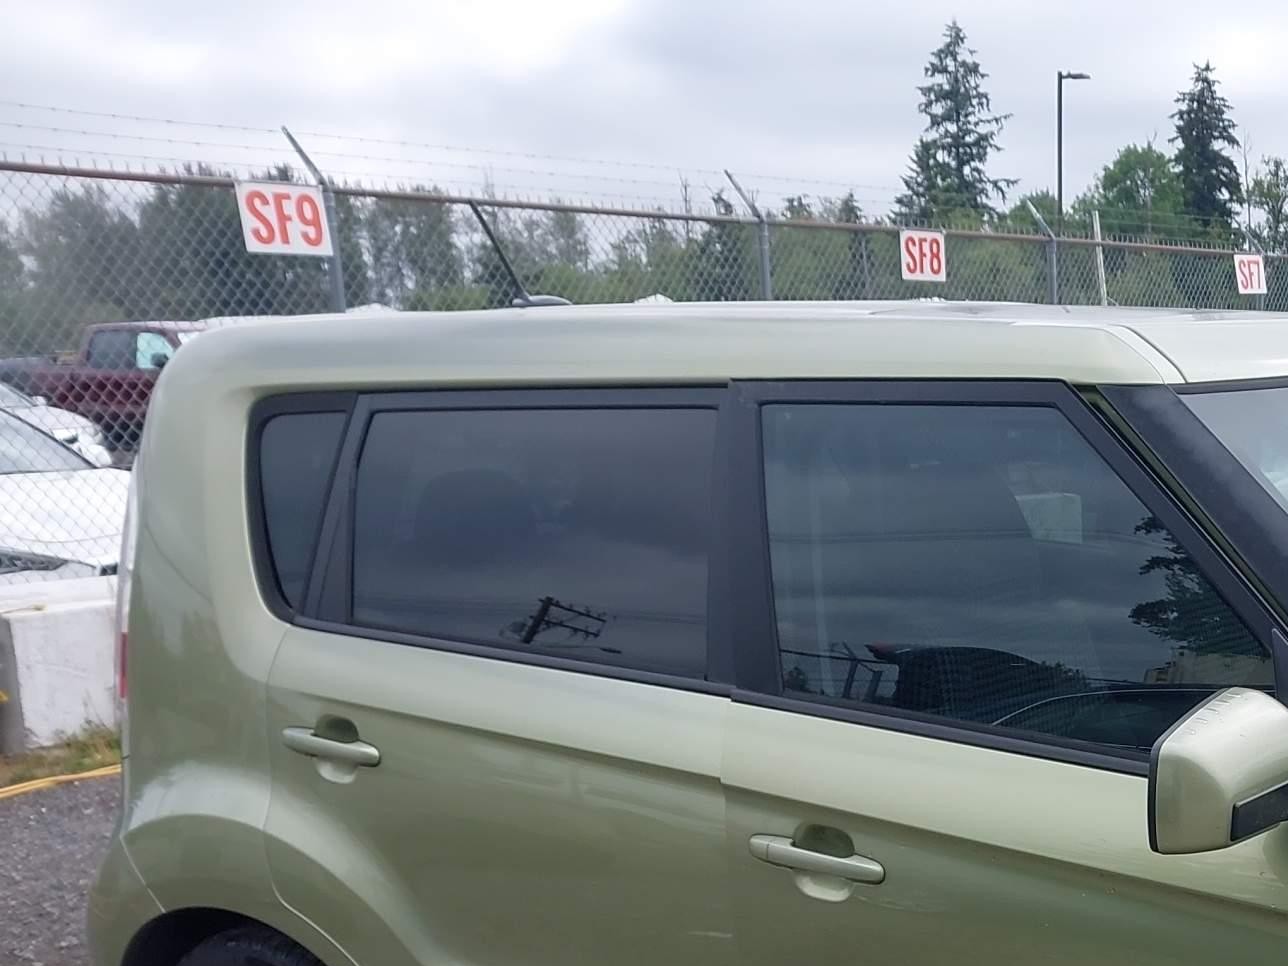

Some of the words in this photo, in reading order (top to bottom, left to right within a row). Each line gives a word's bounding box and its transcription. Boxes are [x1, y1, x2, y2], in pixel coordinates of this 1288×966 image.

[245, 190, 323, 247] SF9
[905, 236, 942, 275] SF8
[1238, 260, 1261, 290] SF7
